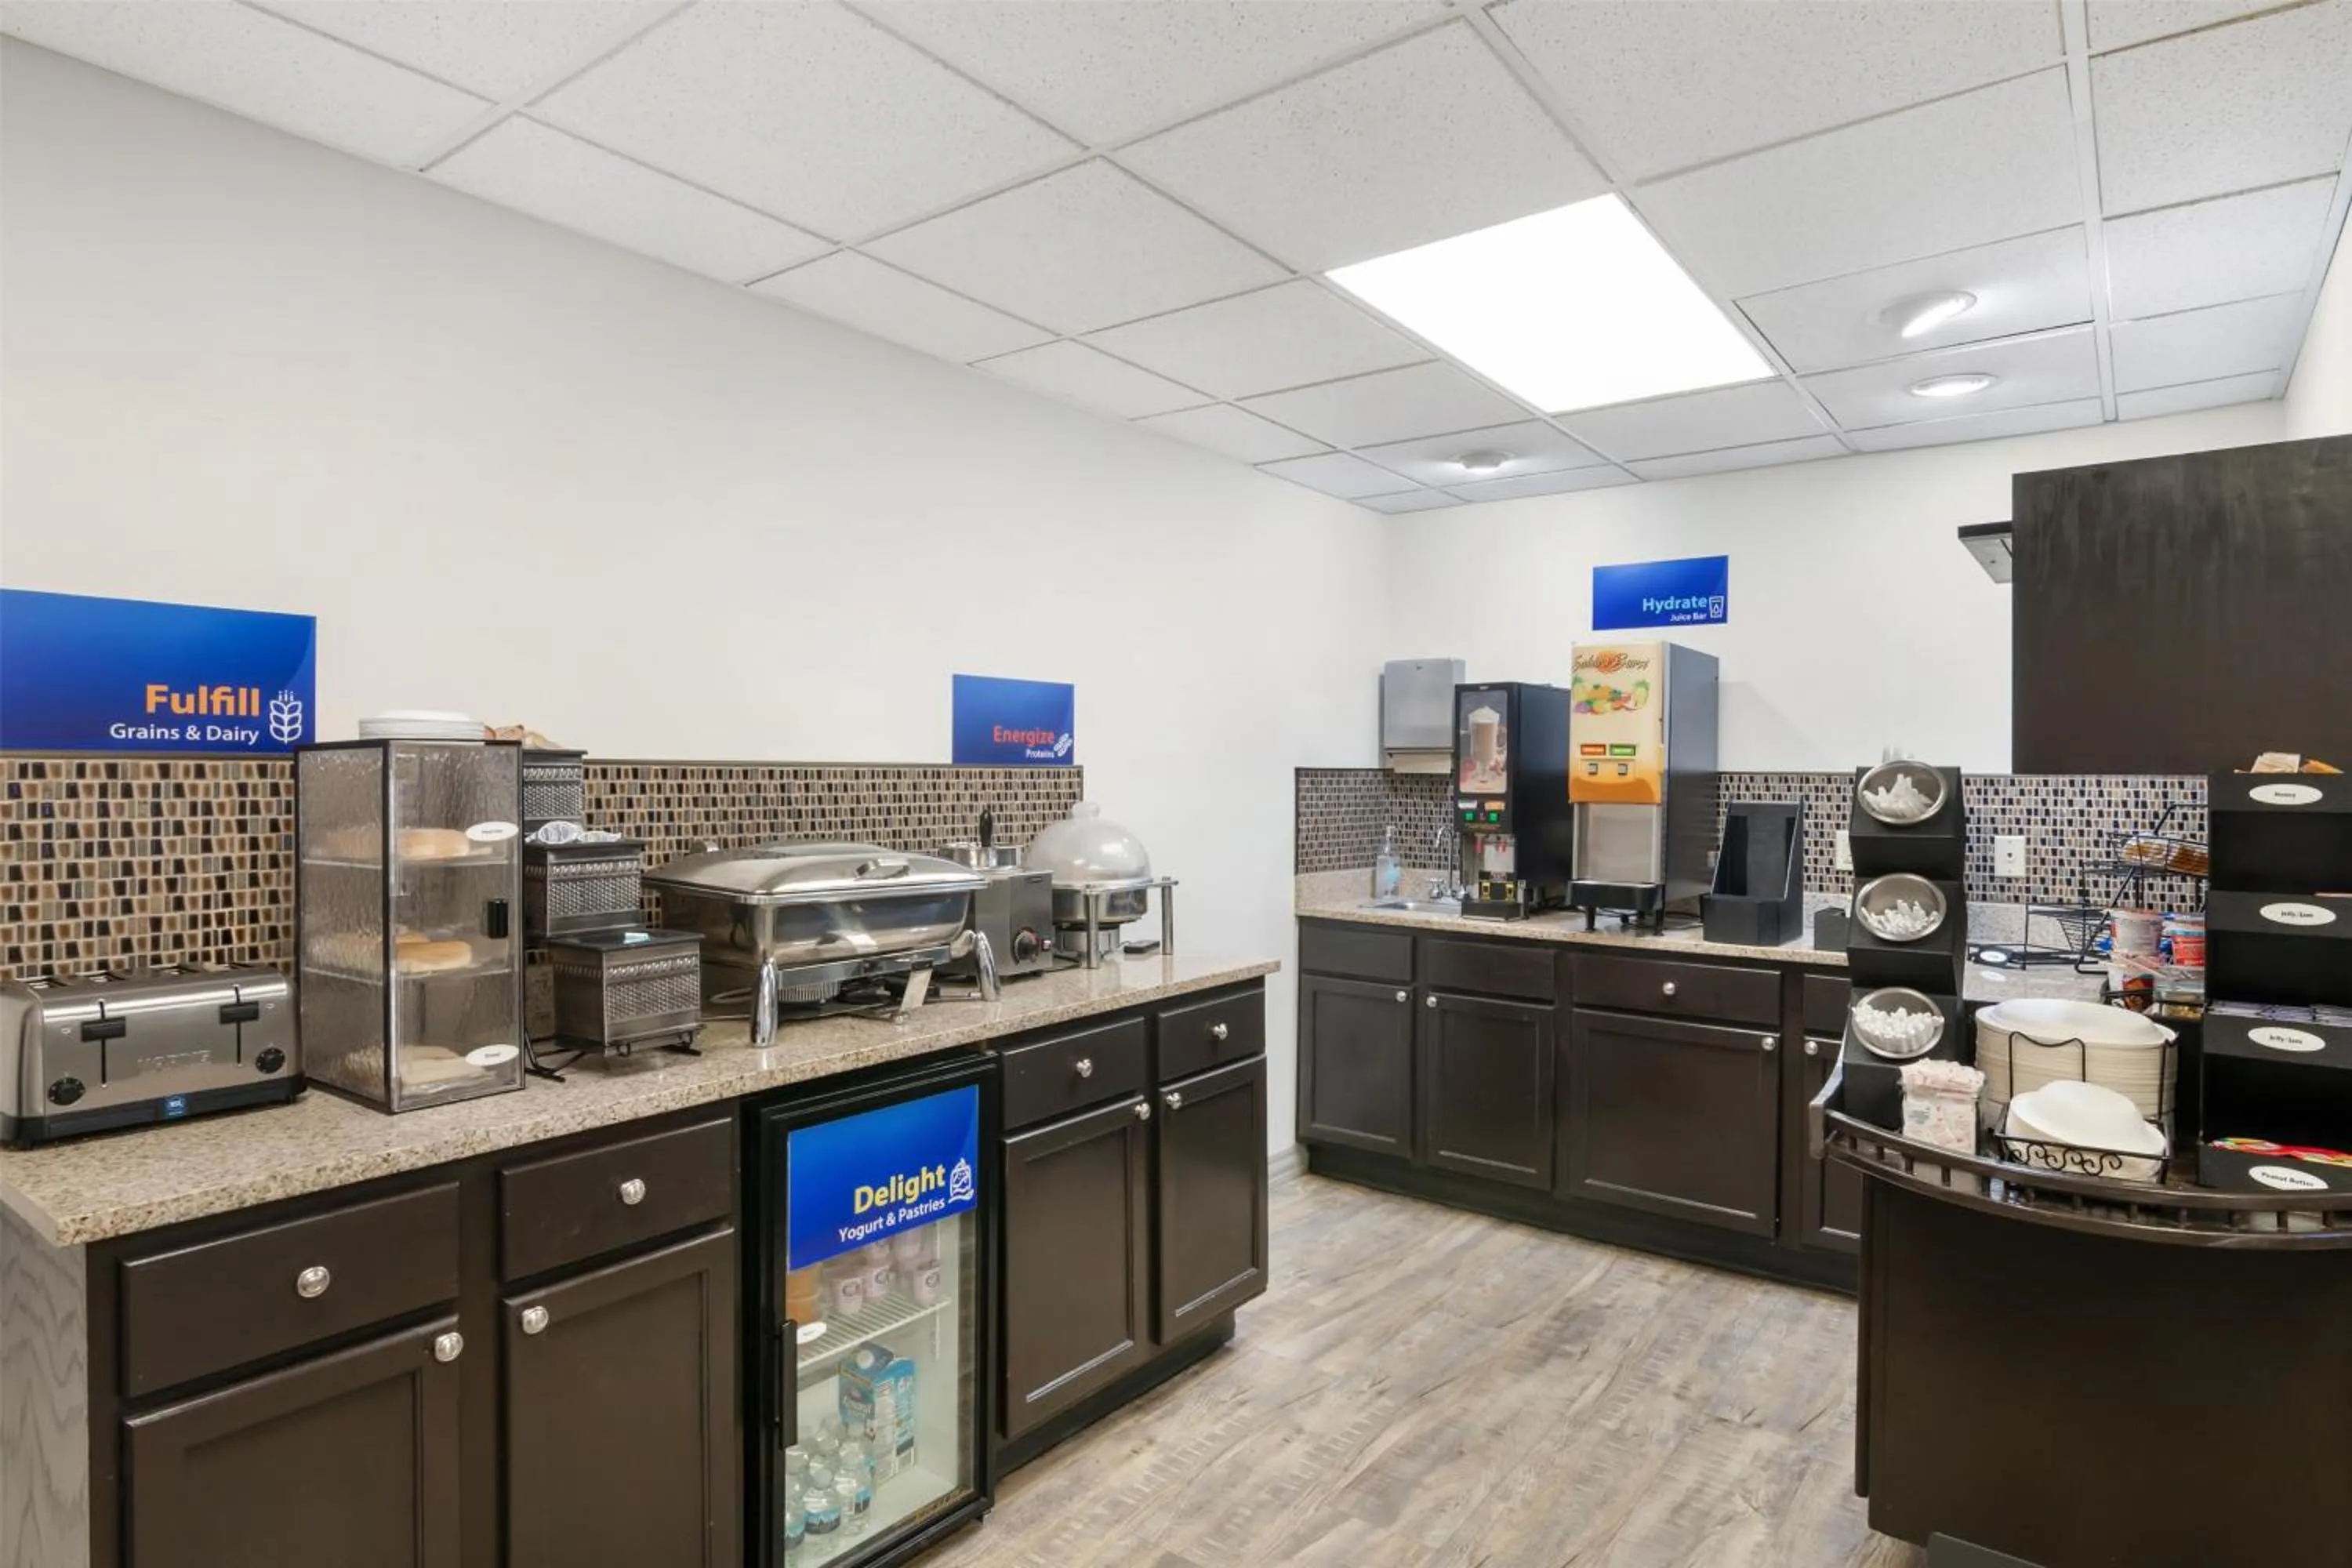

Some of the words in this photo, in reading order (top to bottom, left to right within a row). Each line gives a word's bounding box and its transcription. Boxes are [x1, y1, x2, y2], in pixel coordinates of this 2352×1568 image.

[1642, 596, 1708, 614] Hydrate
[1670, 613, 1691, 622] Juice
[146, 684, 260, 717] Fulfill
[110, 723, 180, 740] Grains
[186, 725, 201, 741] &
[206, 725, 260, 745] Dairy
[993, 725, 1054, 748] Energize
[855, 1163, 946, 1214] Delight
[839, 1217, 884, 1243] Yogurt
[885, 1212, 897, 1228] &
[898, 1198, 946, 1223] Pastries
